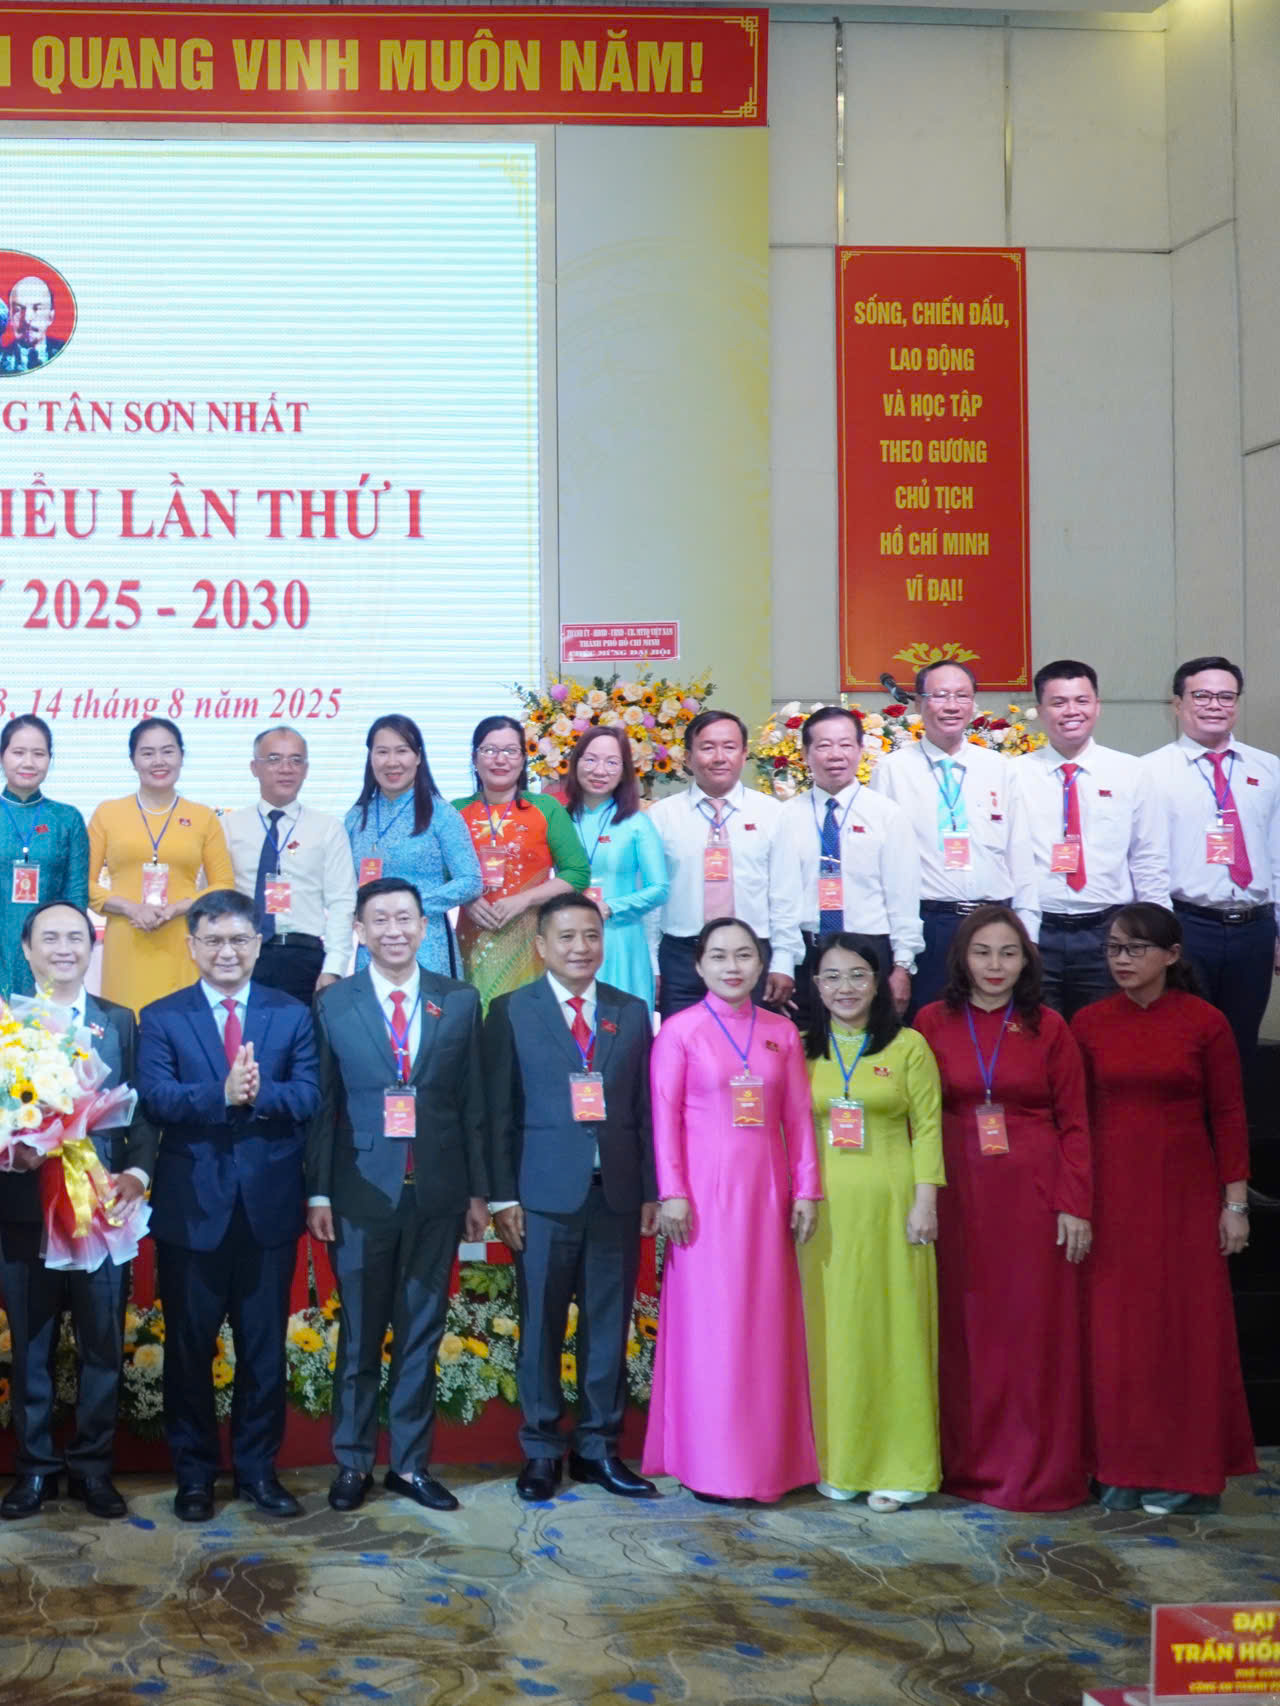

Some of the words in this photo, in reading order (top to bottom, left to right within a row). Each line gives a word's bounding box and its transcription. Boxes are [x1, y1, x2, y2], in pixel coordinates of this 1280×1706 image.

[32, 36, 214, 94] QUANG
[232, 39, 359, 92] VINH
[379, 28, 540, 93] MUÔN
[560, 28, 704, 94] NĂM!
[854, 294, 907, 327] SỐNG,
[912, 295, 964, 325] CHIẾN
[969, 295, 1009, 328] ĐẤU,
[890, 348, 921, 371] LAO
[926, 344, 975, 375] ĐỘNG
[39, 392, 112, 432] TÂN
[124, 399, 195, 433] SƠN
[207, 392, 309, 433] NHẤT
[883, 389, 905, 416] VÀ
[911, 394, 945, 421] HỌC
[949, 390, 983, 422] TẬP
[880, 440, 923, 463] THEO
[928, 437, 987, 463] GƯƠNG
[119, 472, 240, 538] LẦN
[257, 473, 391, 539] THỨ
[404, 489, 425, 539] I
[895, 478, 930, 509] CHỦ
[935, 486, 973, 514] TỊCH
[880, 525, 904, 555] HỒ
[909, 527, 937, 555] CHÍ
[943, 533, 989, 555] MINH
[23, 579, 142, 630] 2025
[157, 607, 176, 616] -
[192, 579, 310, 630] 2030
[906, 574, 923, 601] VĨ
[927, 578, 964, 606] ĐẠI!
[31, 688, 62, 719] 14
[72, 688, 160, 720] tháng
[168, 688, 185, 719] 8
[194, 689, 259, 719] năm
[269, 688, 342, 719] 2025
